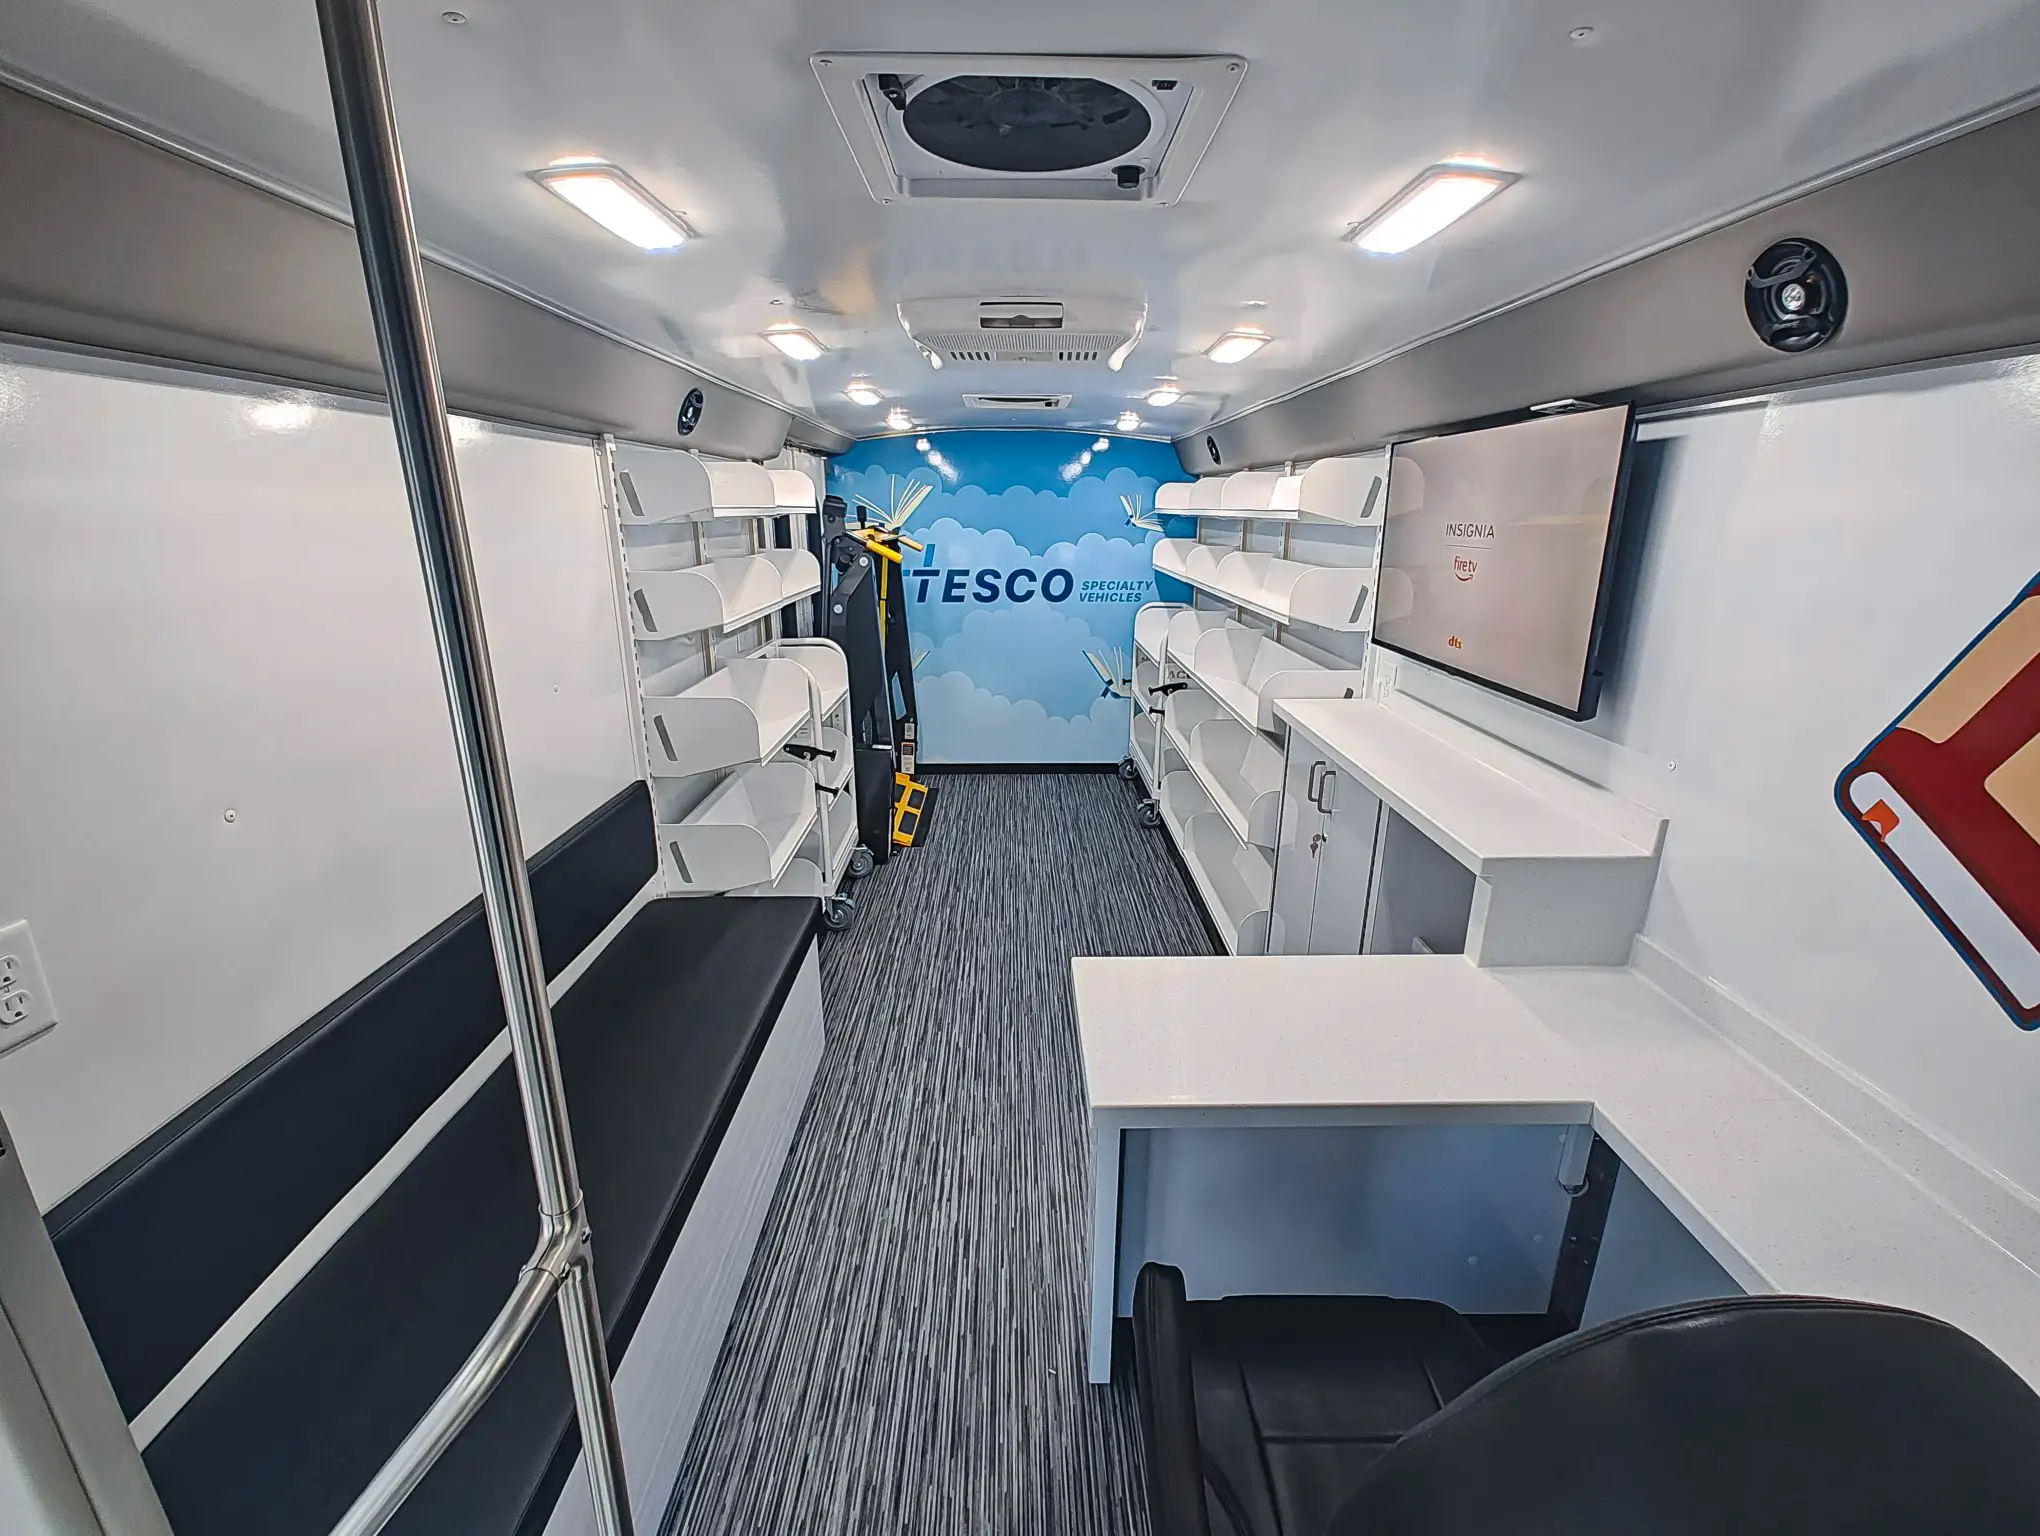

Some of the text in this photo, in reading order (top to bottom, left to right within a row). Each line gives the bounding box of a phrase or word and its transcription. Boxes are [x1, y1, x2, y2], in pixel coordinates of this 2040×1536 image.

[1445, 523, 1494, 539] INSIGNIA
[911, 568, 1074, 603] TESCO
[1081, 580, 1154, 591] SPECIALTY
[1079, 592, 1142, 603] VEHICLES
[1448, 635, 1462, 649] dts
